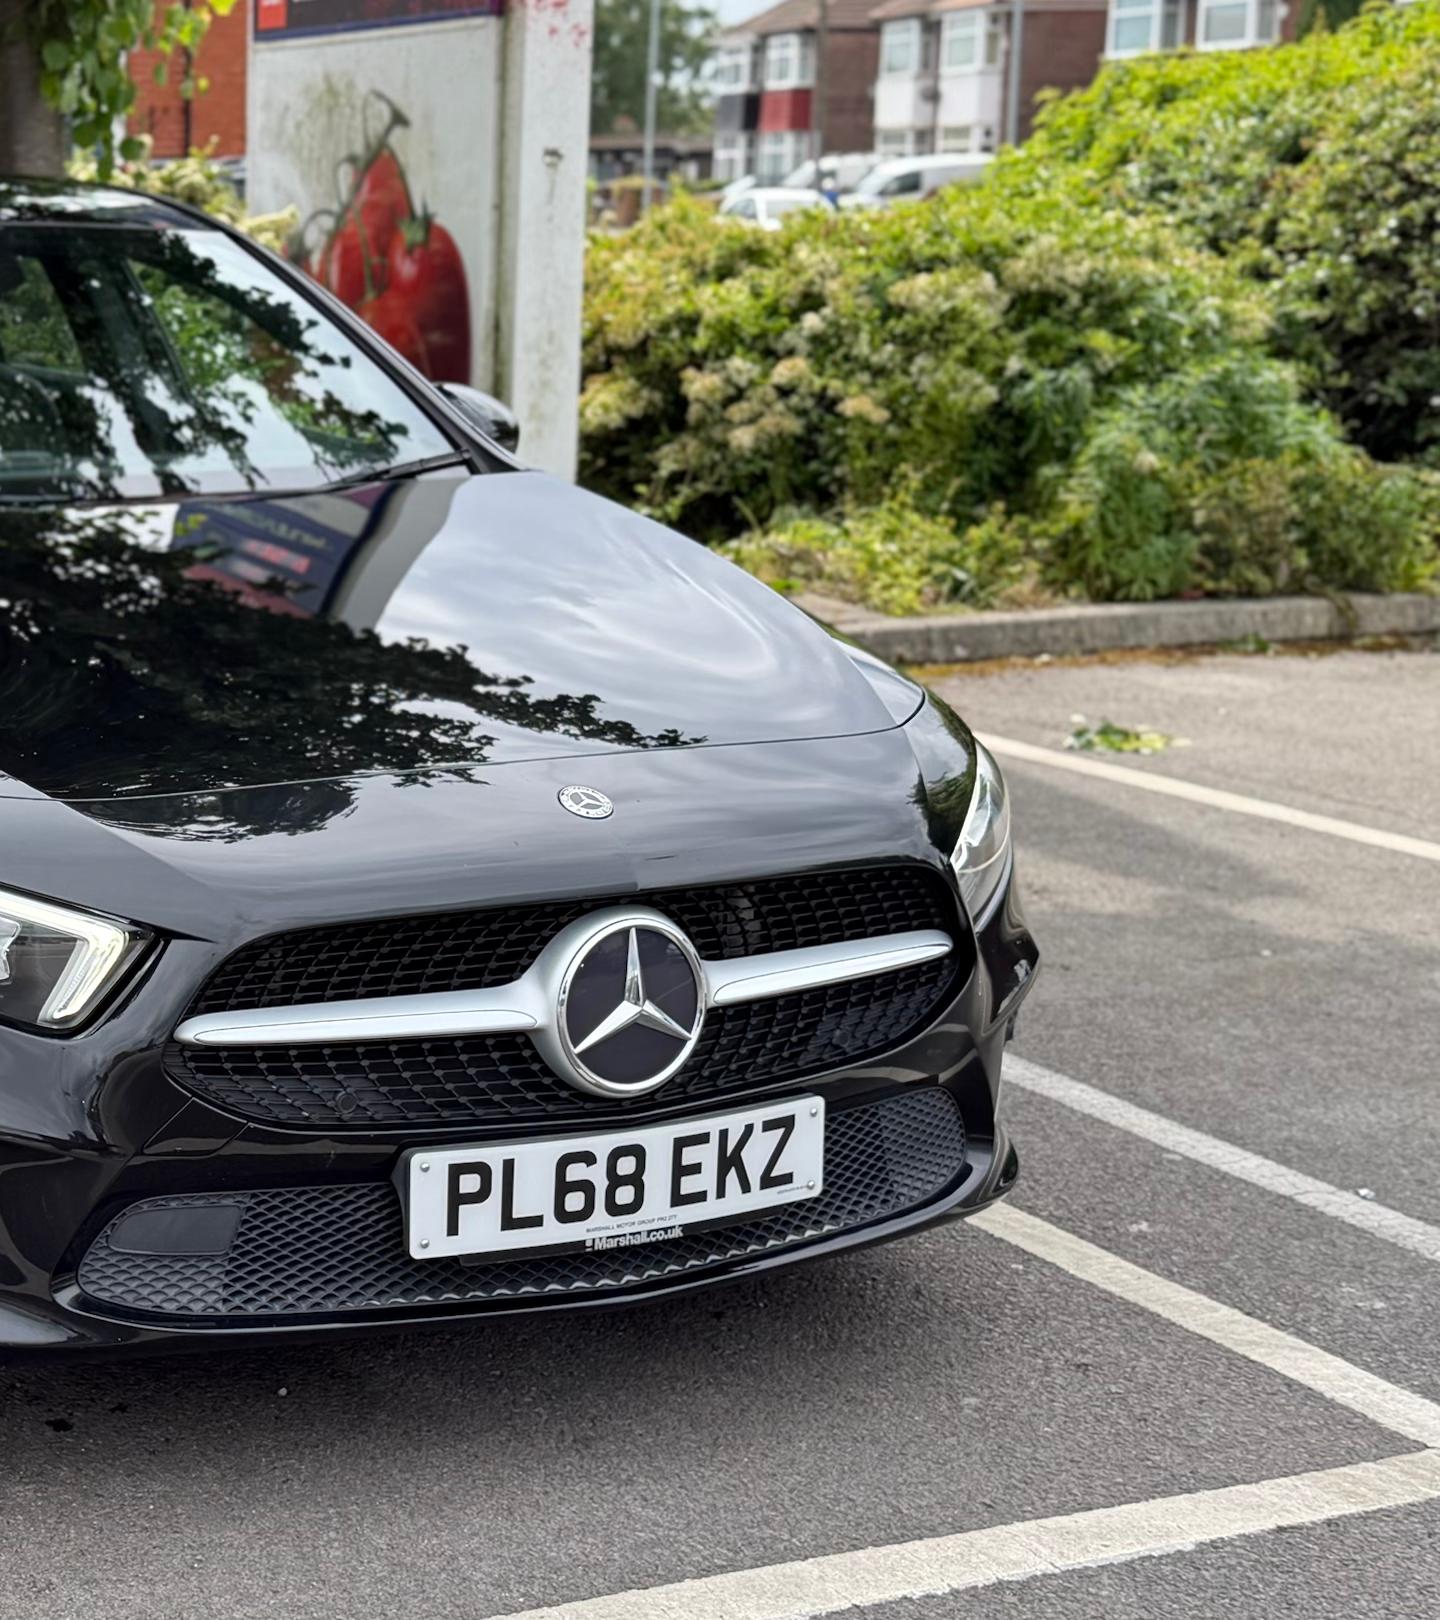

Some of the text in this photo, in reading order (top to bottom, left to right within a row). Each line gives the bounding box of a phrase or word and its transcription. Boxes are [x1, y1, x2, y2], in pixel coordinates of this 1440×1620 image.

[446, 1114, 796, 1237] PL68 EKZ
[594, 1225, 684, 1250] Marshall.co.uk
